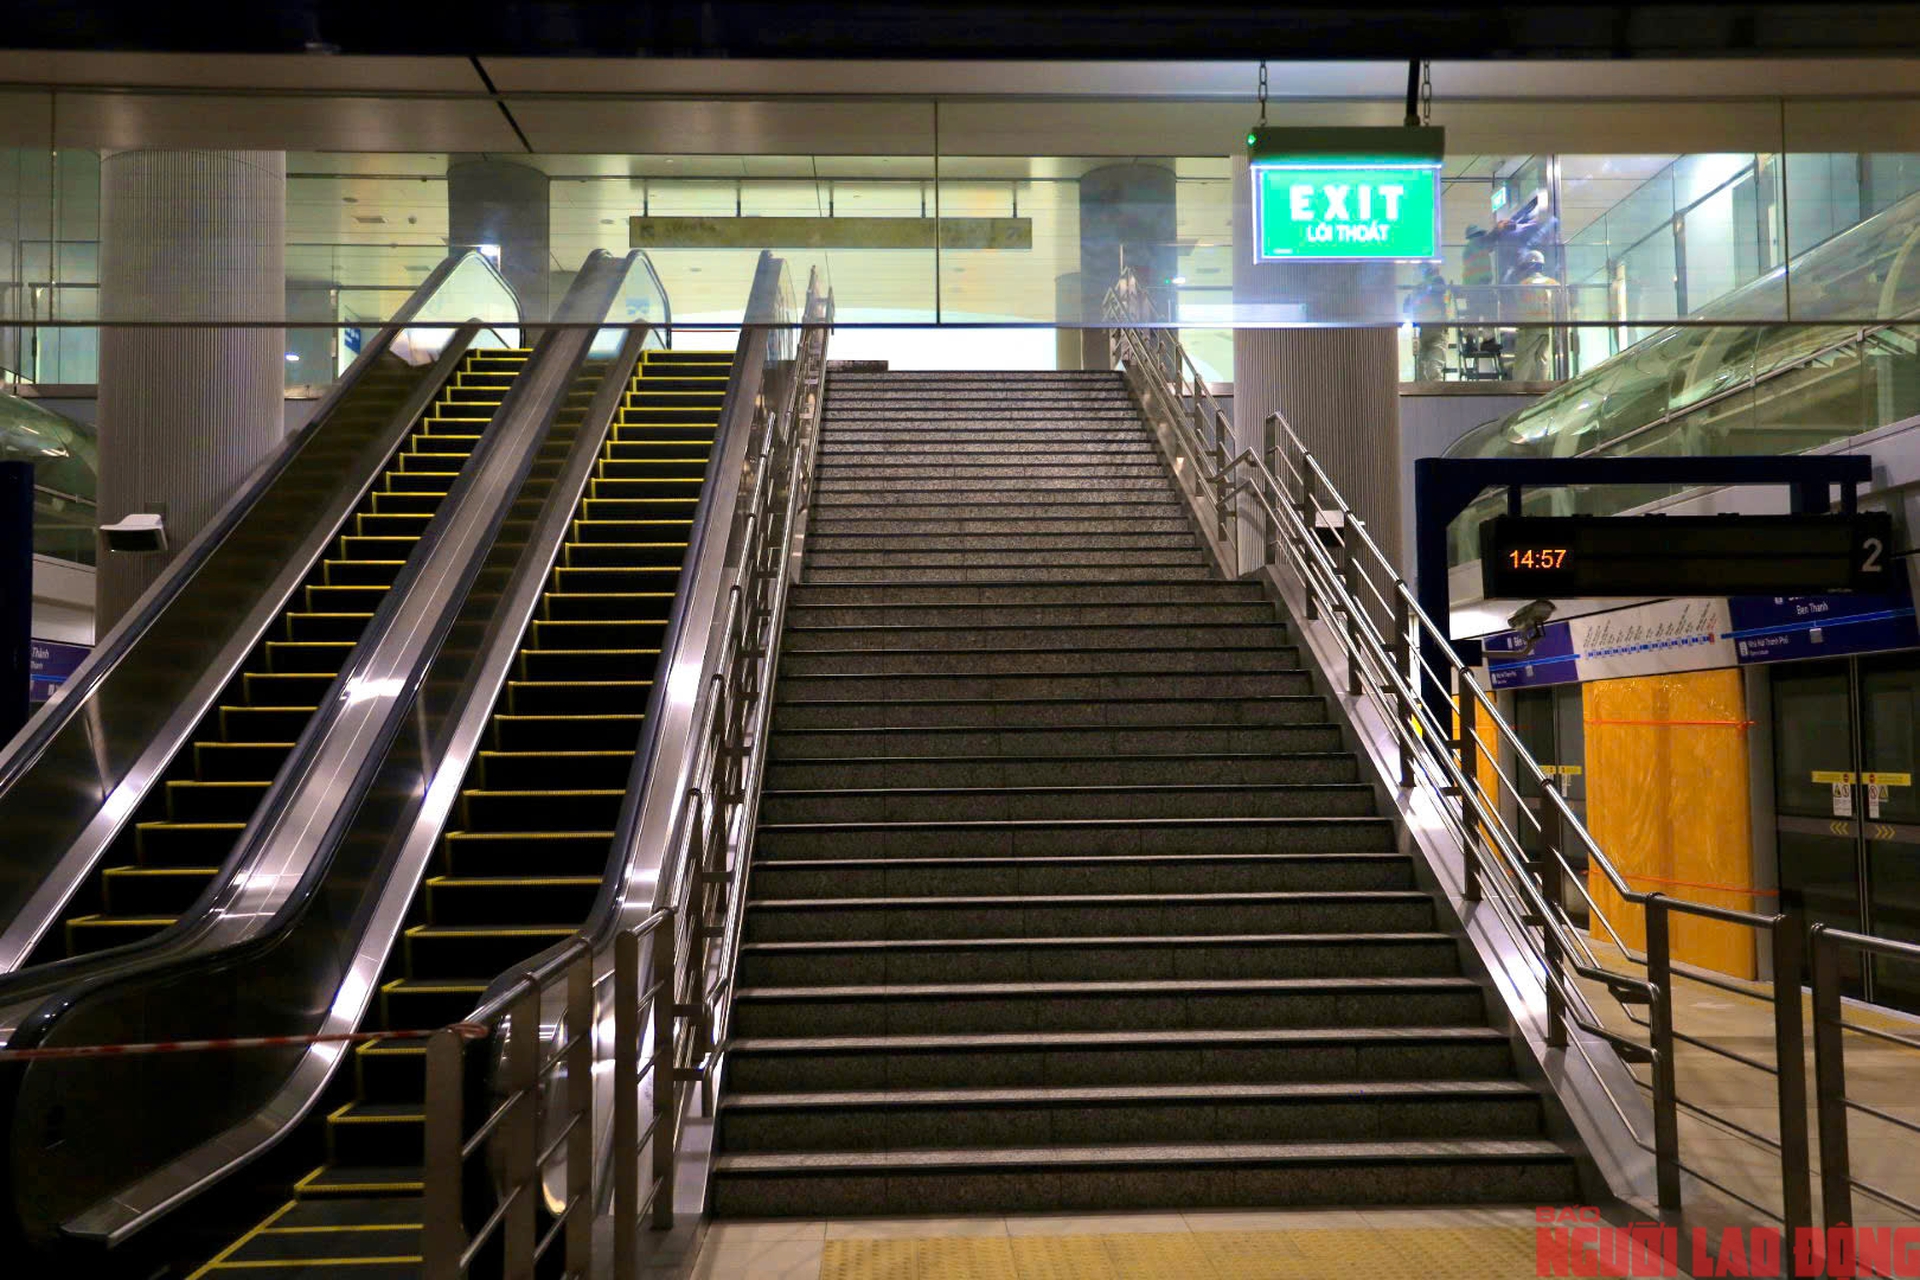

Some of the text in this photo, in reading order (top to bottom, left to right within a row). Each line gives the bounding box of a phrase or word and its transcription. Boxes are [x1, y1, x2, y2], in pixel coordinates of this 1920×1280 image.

[1289, 184, 1404, 221] EXIT
[1336, 220, 1390, 242] THOÁT
[1509, 549, 1567, 569] 14:57
[1862, 537, 1884, 573] 2
